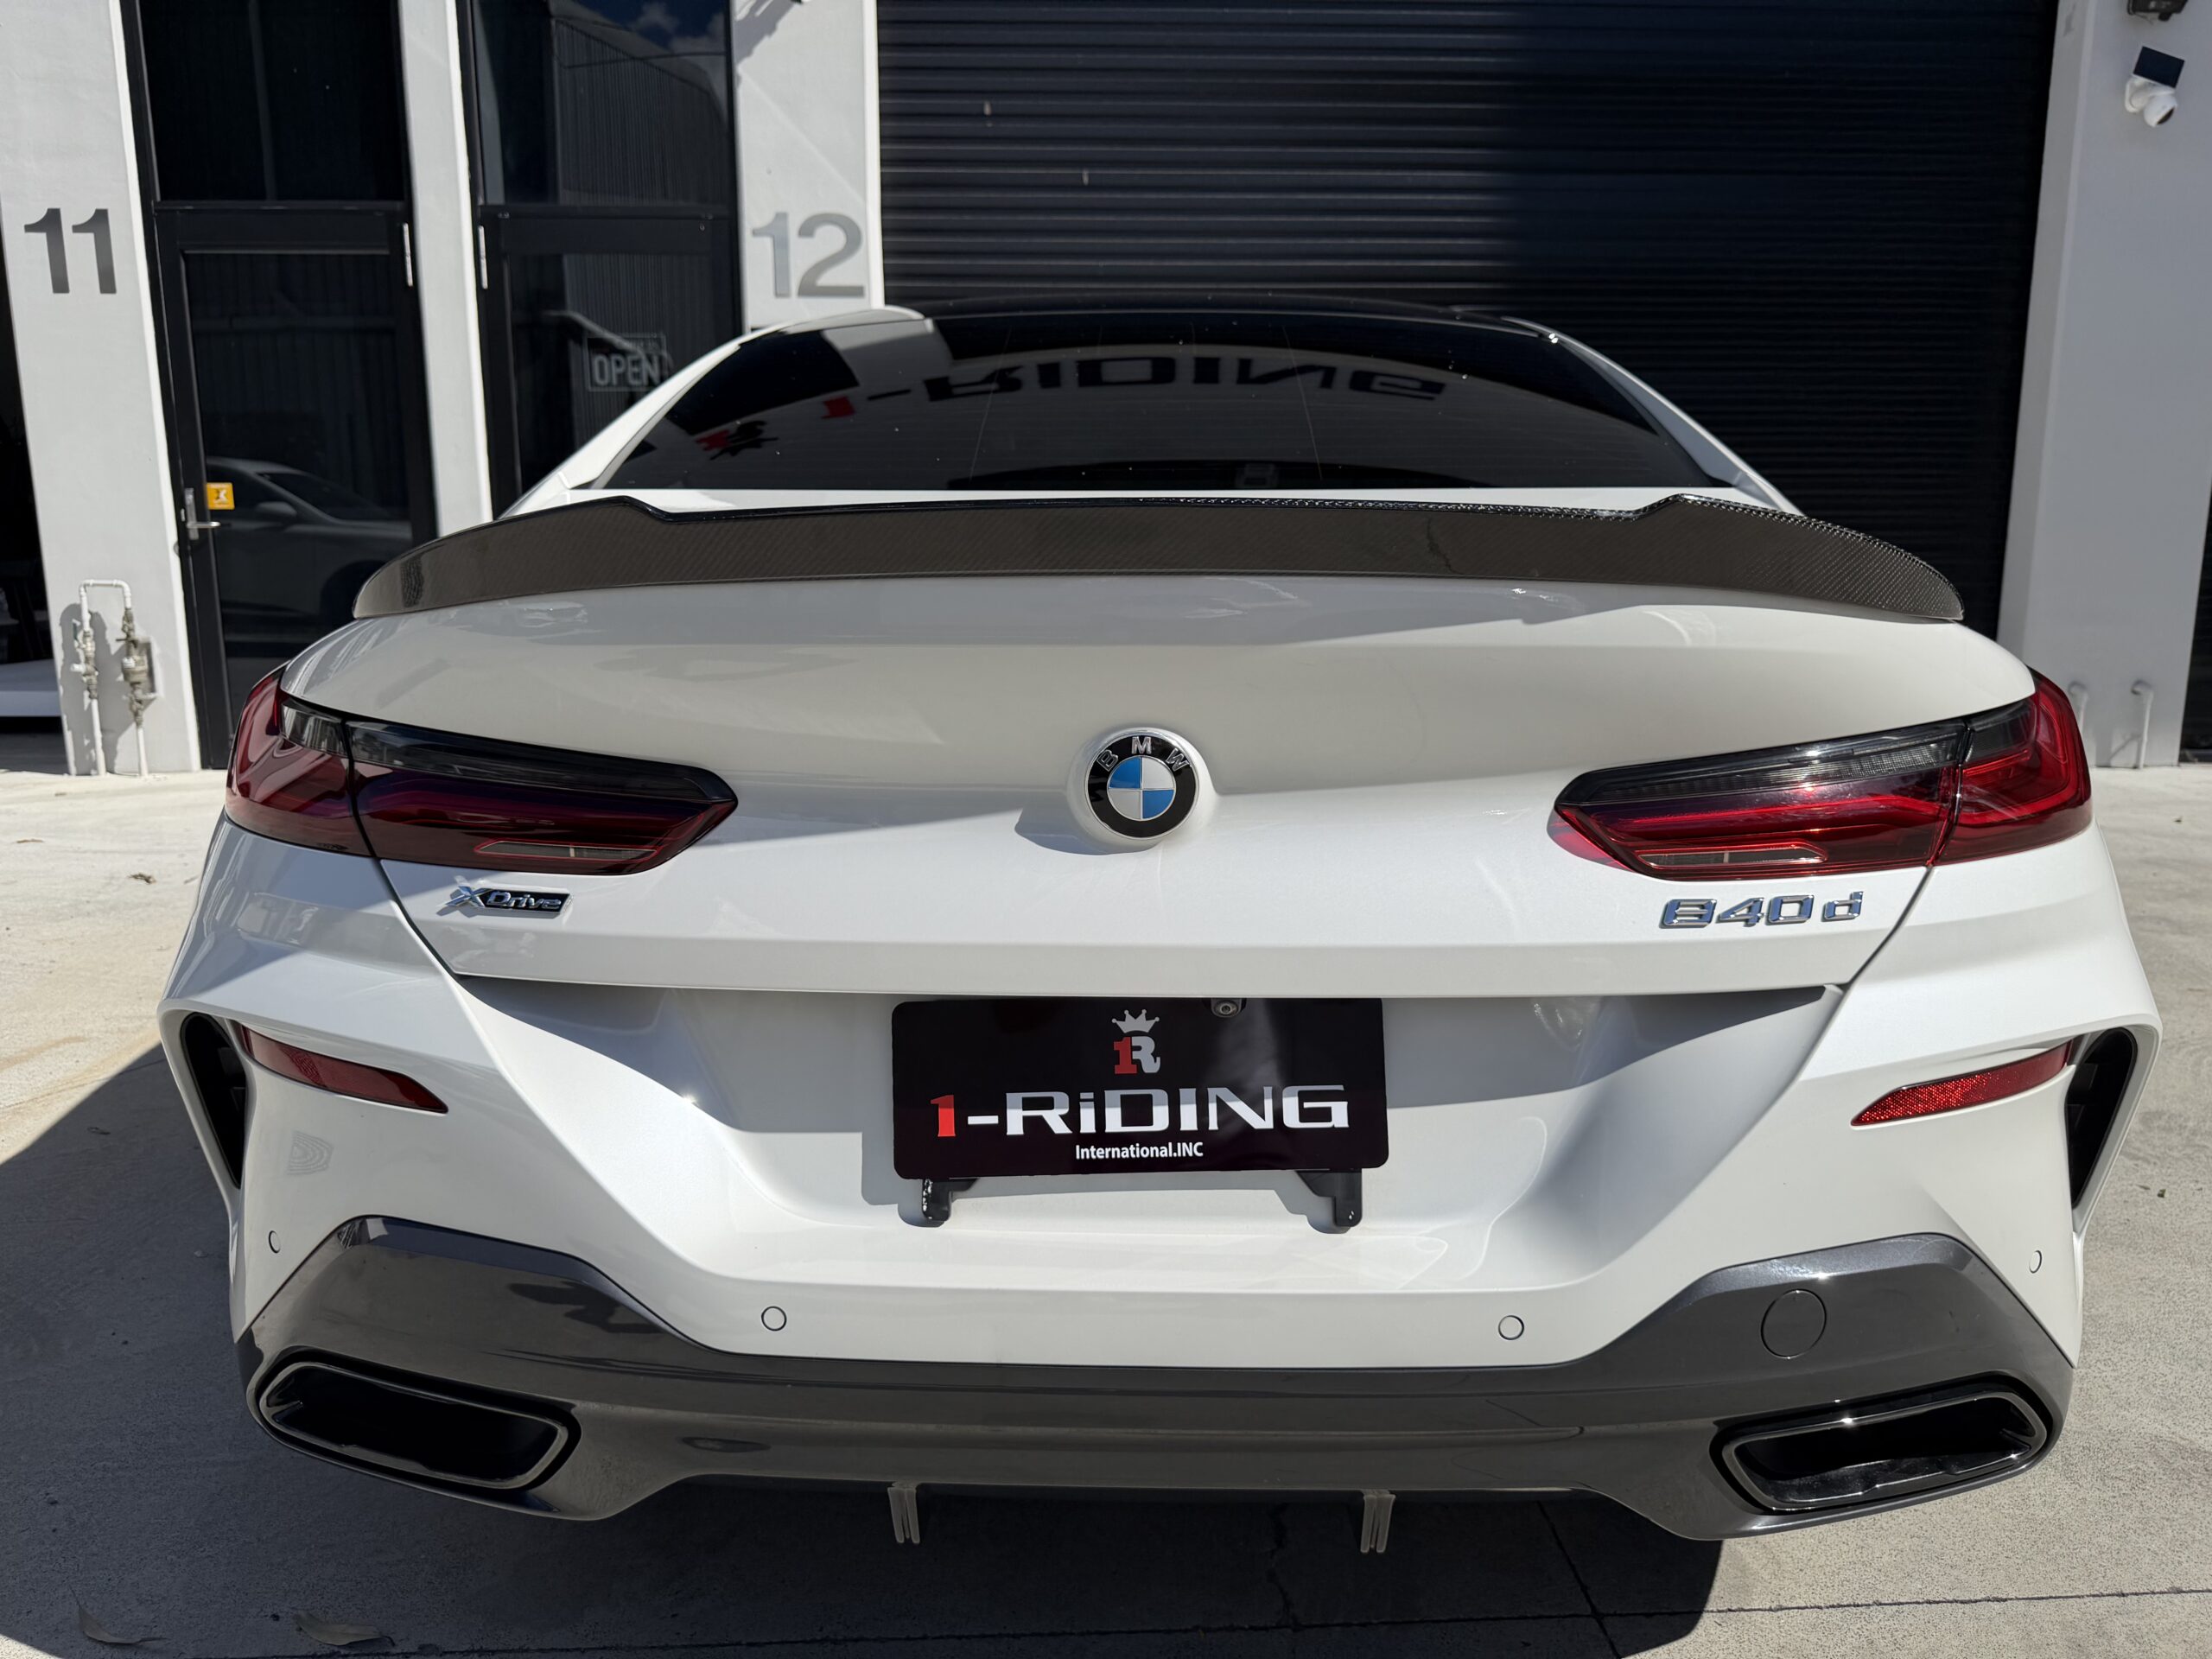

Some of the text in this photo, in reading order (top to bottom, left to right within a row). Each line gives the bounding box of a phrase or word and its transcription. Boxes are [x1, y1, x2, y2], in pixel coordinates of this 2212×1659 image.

[23, 207, 118, 295] 11
[752, 212, 866, 298] 12
[593, 353, 661, 386] OPEN
[1096, 736, 1190, 772] BMW
[1075, 1141, 1204, 1160] International.INC
